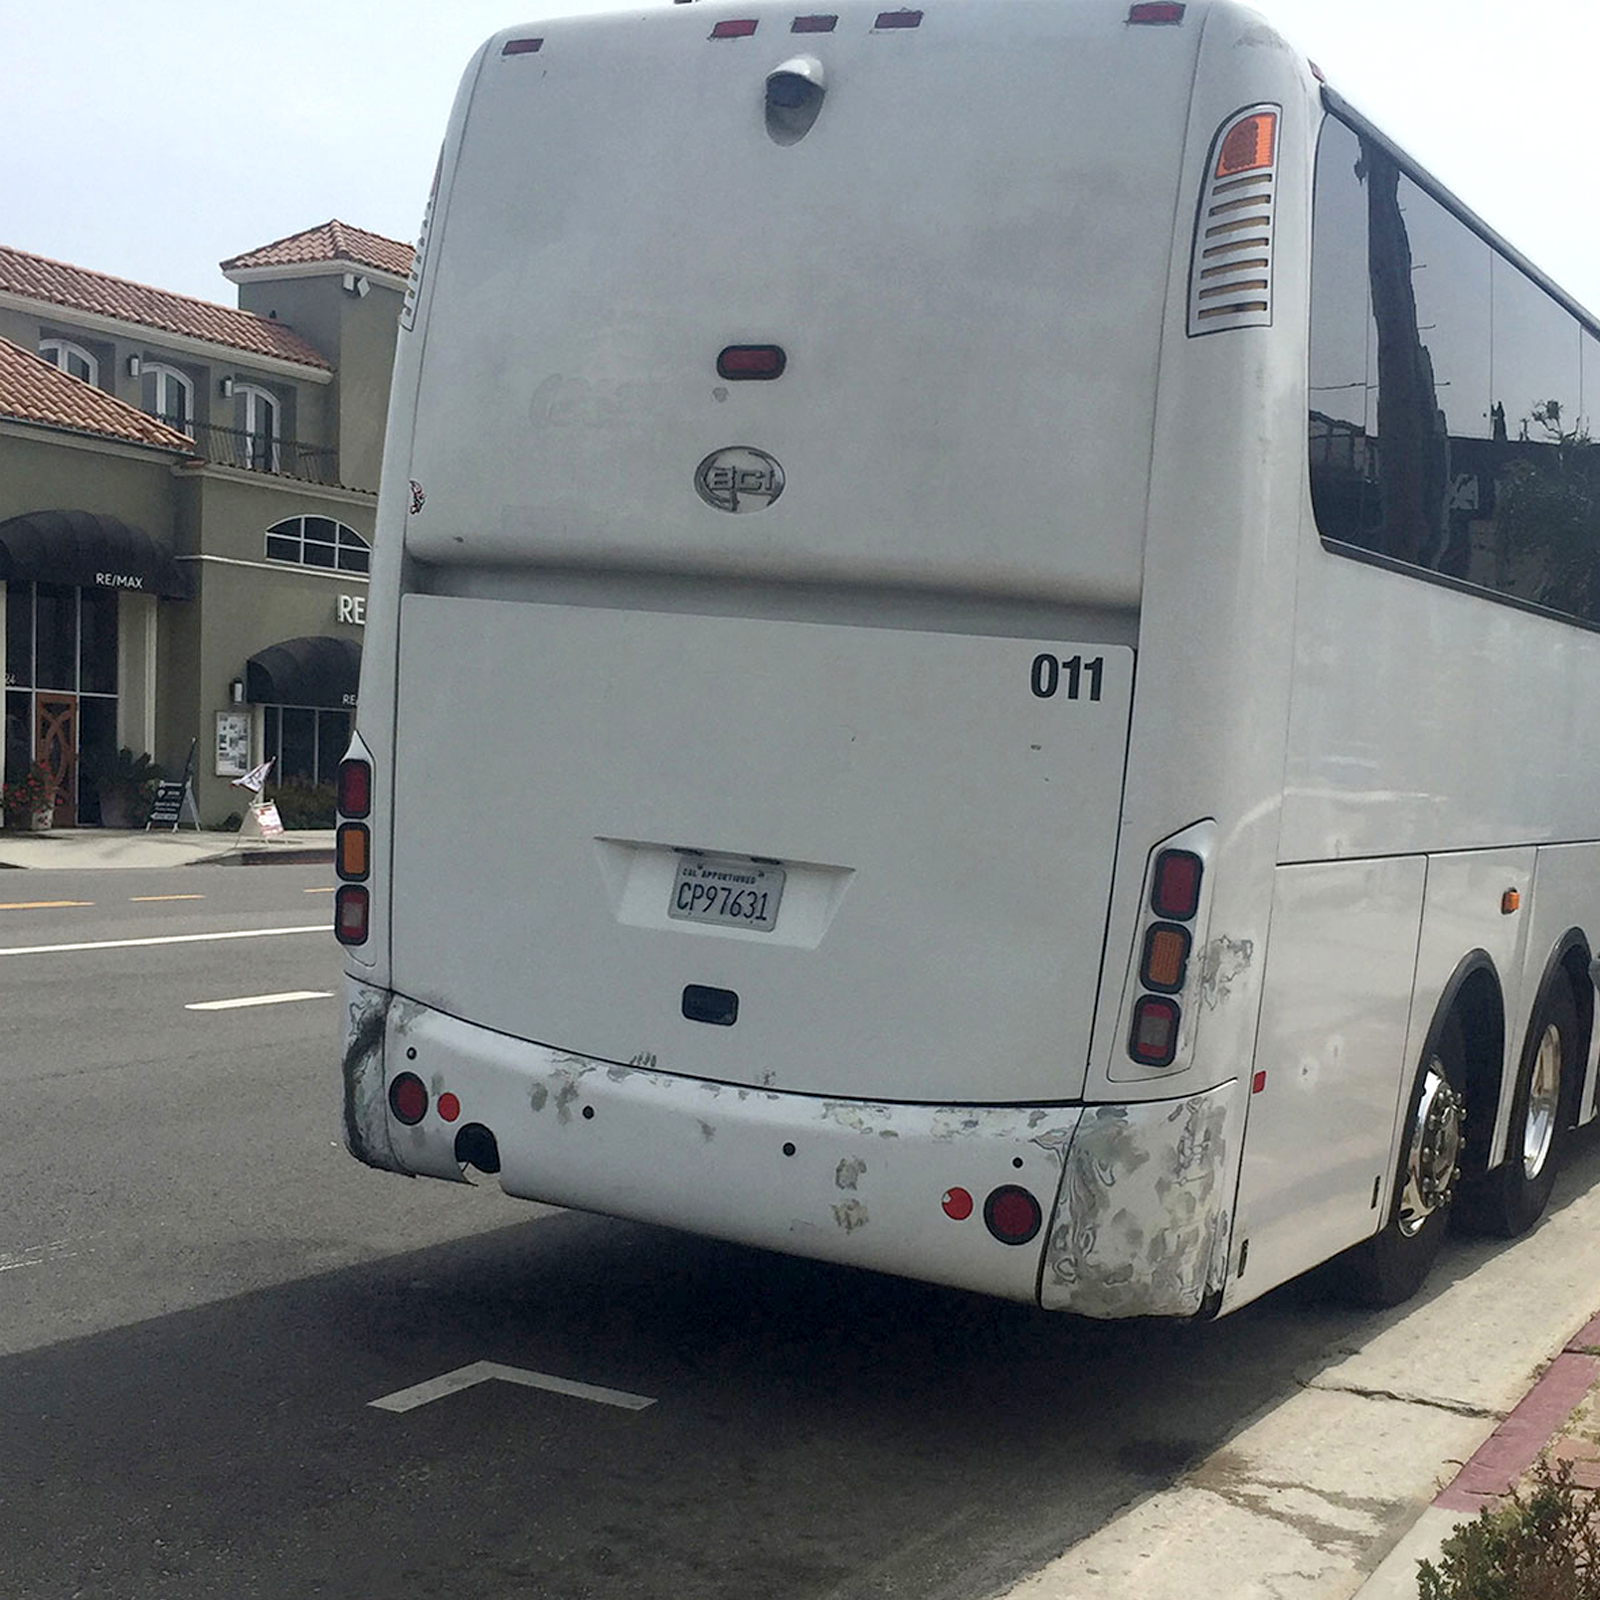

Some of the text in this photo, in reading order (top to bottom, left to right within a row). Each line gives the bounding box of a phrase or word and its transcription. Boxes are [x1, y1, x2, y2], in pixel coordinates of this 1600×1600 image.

[95, 572, 143, 589] RE/MAX
[1030, 653, 1104, 701] 011
[677, 882, 768, 921] CP97631
